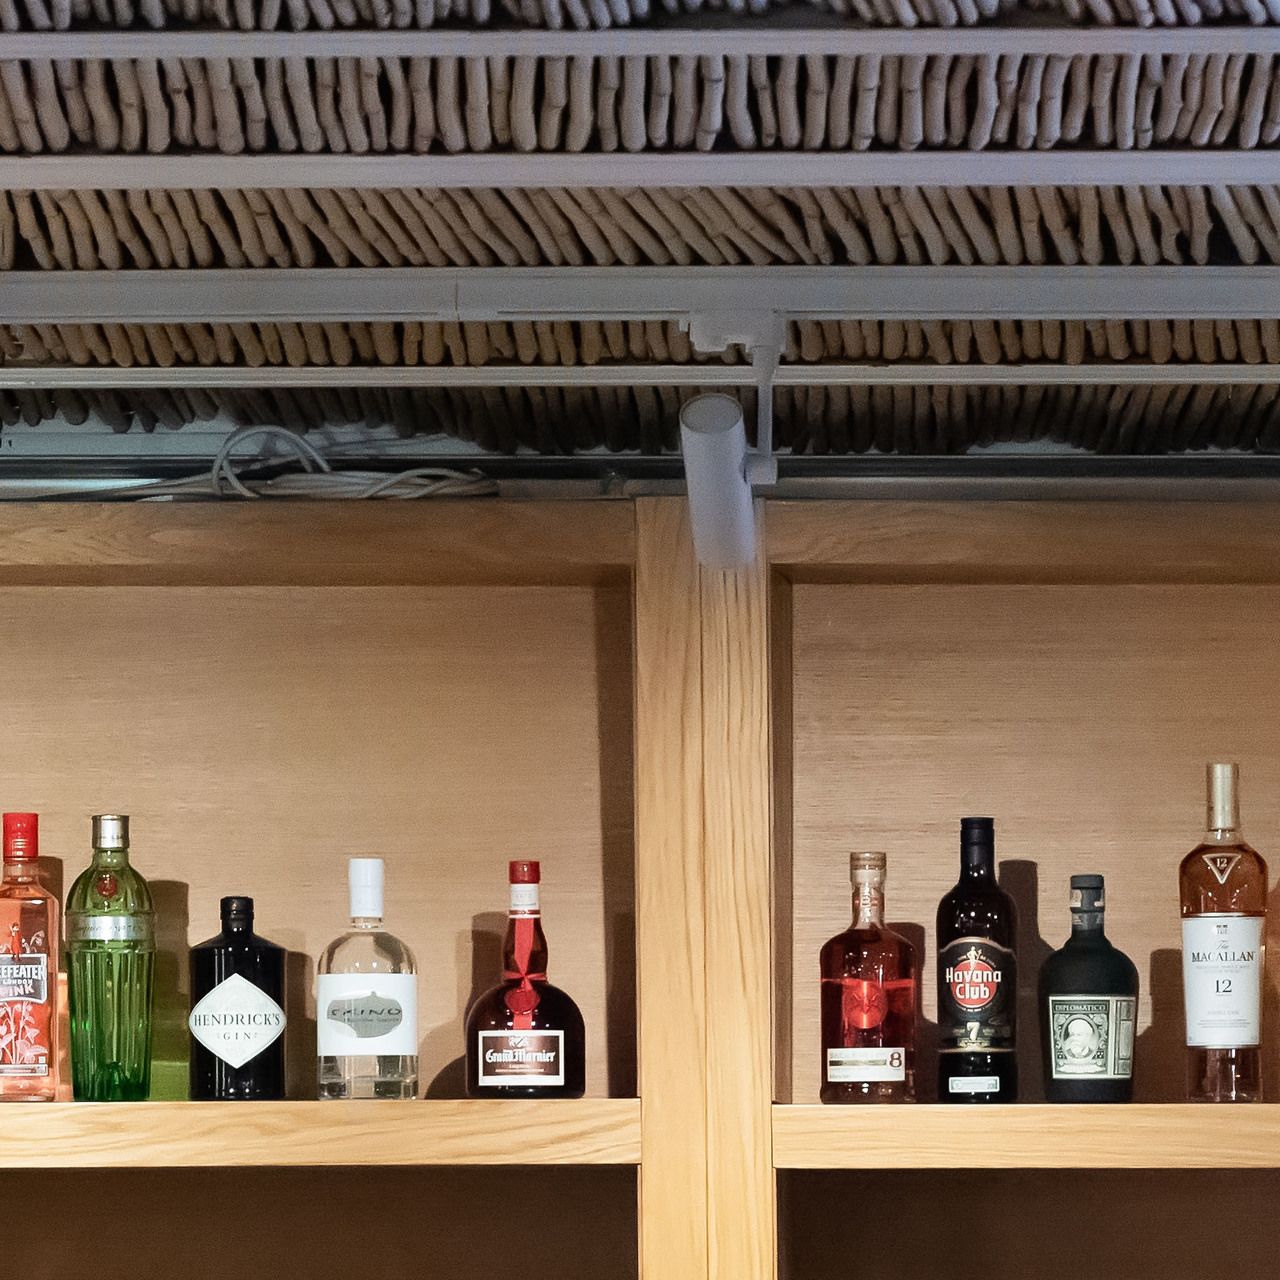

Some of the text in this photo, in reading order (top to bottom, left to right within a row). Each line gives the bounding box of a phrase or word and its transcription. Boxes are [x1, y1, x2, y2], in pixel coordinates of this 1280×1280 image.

[1216, 858, 1228, 868] 12
[1192, 951, 1254, 963] MACALLAN
[946, 967, 1002, 983] Havana
[0, 984, 35, 997] PINK
[956, 983, 990, 999] Club
[1215, 979, 1232, 994] 12
[194, 1012, 281, 1027] HENDRICK'S
[223, 1032, 252, 1040] GIN
[966, 1021, 980, 1041] 7
[889, 1051, 902, 1068] 8
